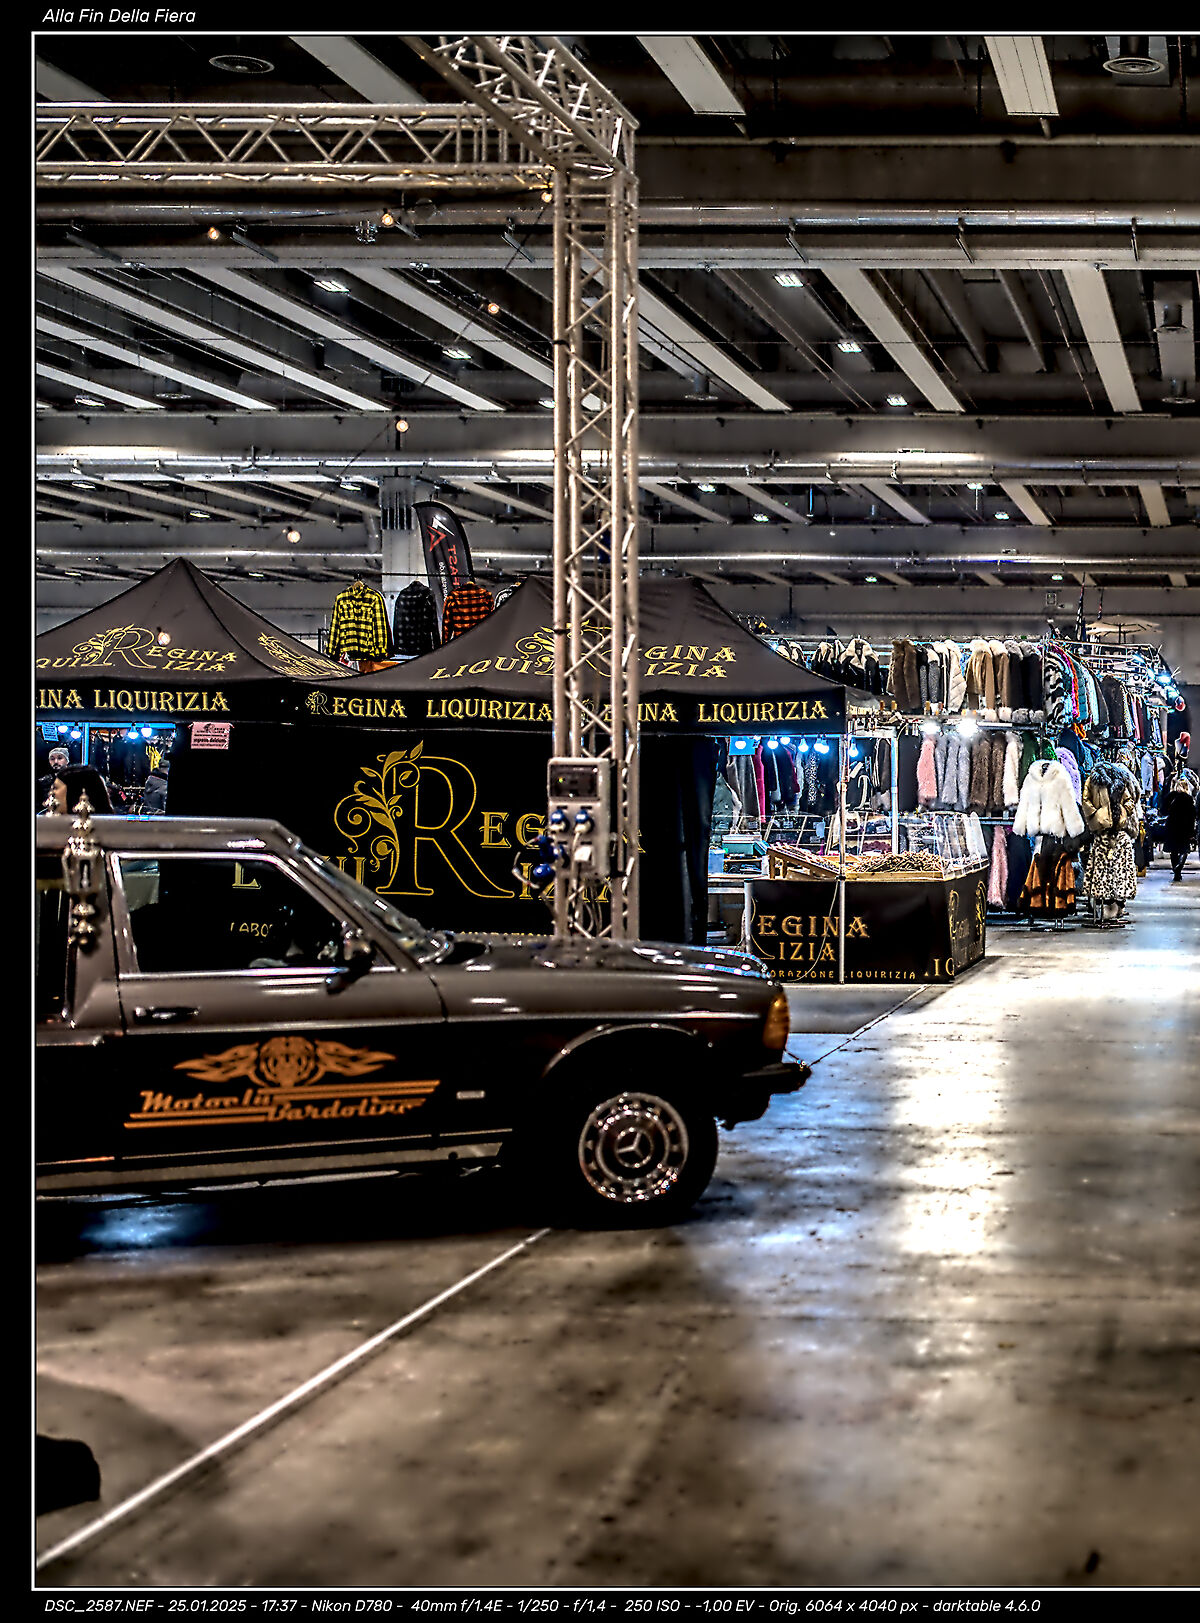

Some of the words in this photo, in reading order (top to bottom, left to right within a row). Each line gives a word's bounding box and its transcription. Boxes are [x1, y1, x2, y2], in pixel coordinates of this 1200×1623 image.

[36, 688, 84, 710] INA
[93, 688, 231, 713] LIQUIRIZIA
[305, 690, 408, 718] REGINA
[425, 697, 553, 722] LIQUIRIZIA
[697, 700, 829, 724] LIQUIRIZIA
[757, 914, 871, 939] EGINA
[770, 969, 835, 980] ORAZIONE
[844, 970, 917, 981] IQUIRIZIA
